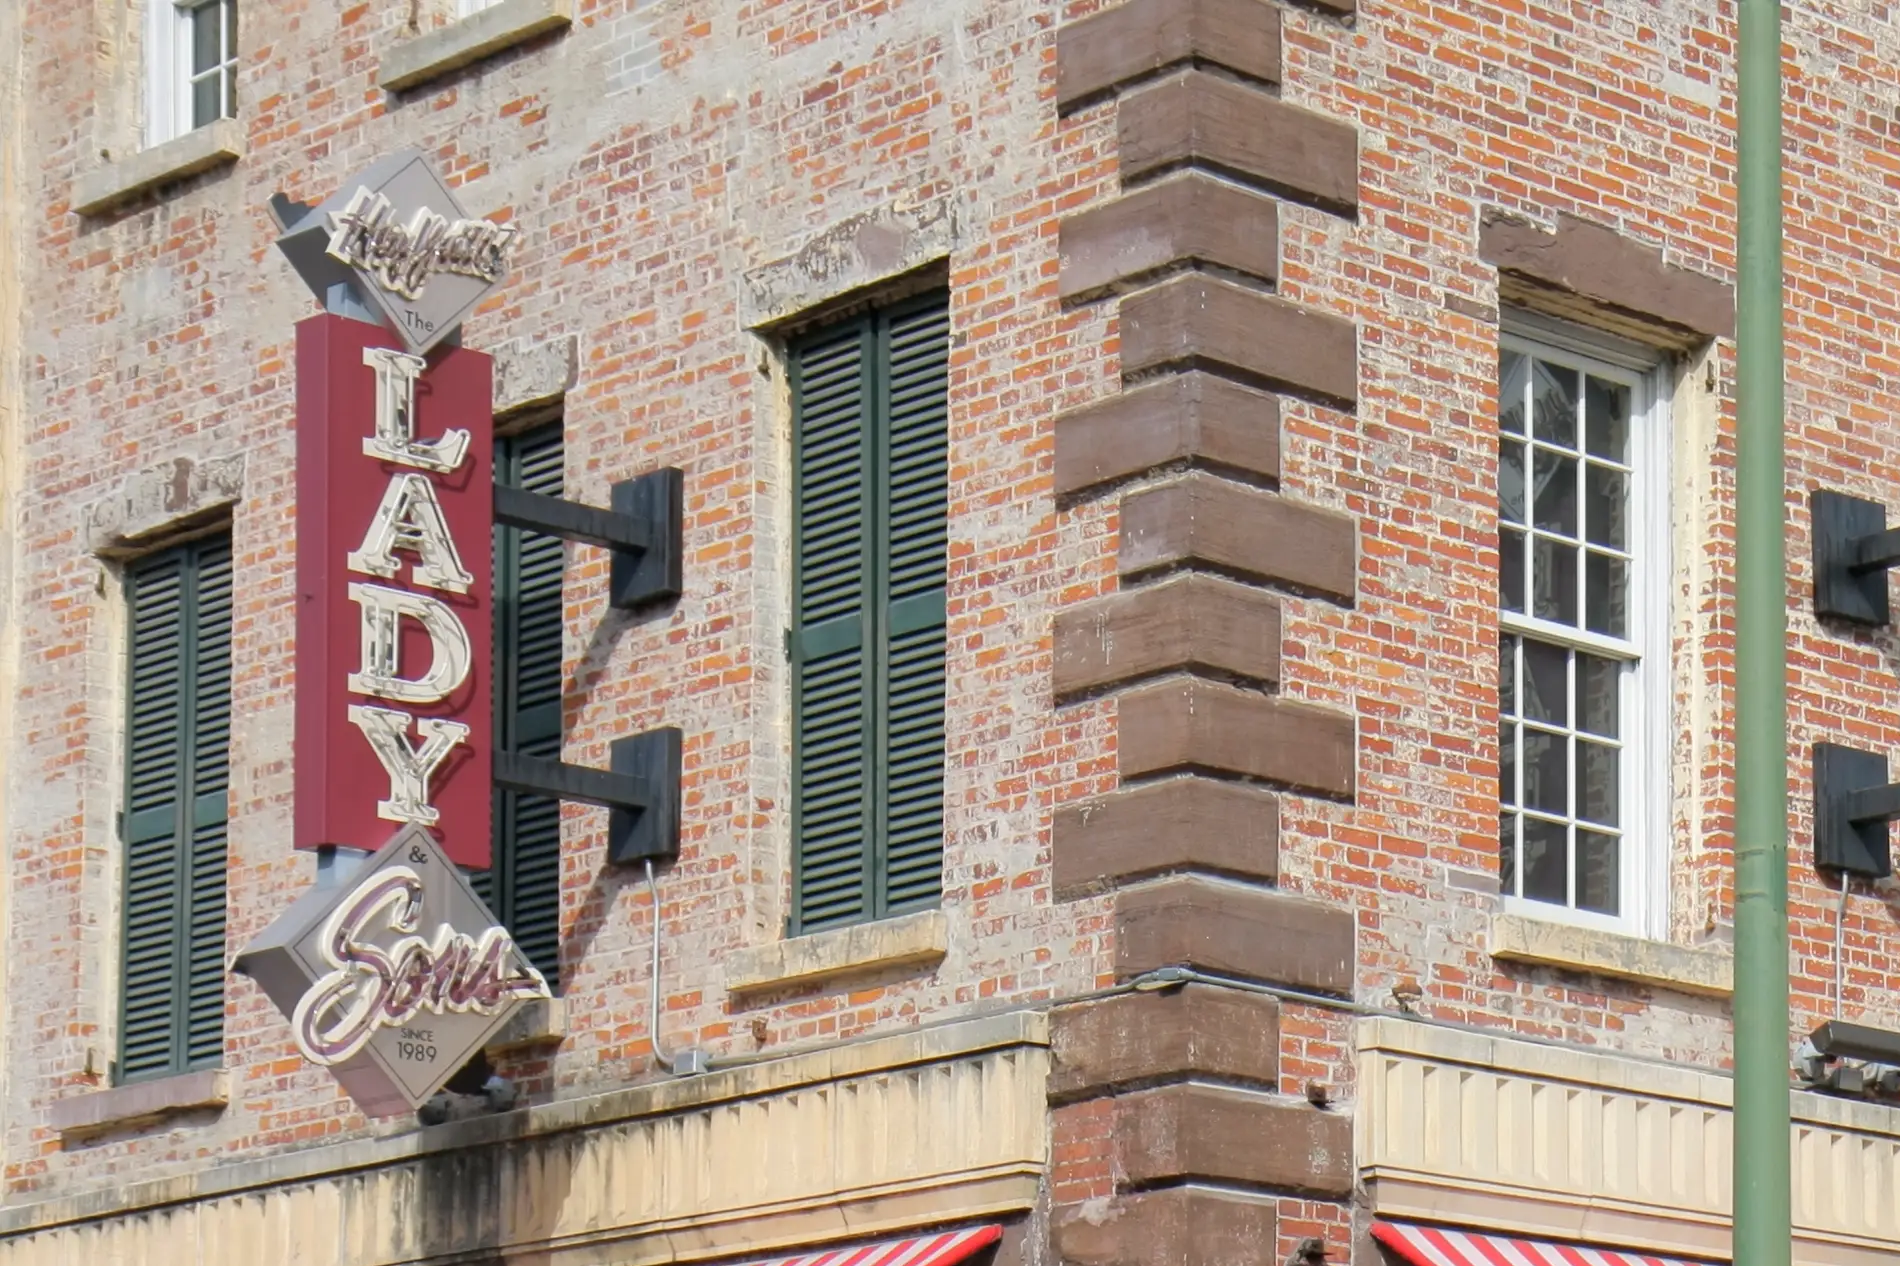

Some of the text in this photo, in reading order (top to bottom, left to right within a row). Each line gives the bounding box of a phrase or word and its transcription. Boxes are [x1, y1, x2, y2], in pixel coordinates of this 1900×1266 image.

[404, 309, 435, 333] The
[347, 346, 474, 824] LADY
[408, 845, 429, 866] &
[291, 864, 552, 1066] Sons
[400, 1027, 435, 1043] SINCE
[396, 1041, 437, 1064] 1989
